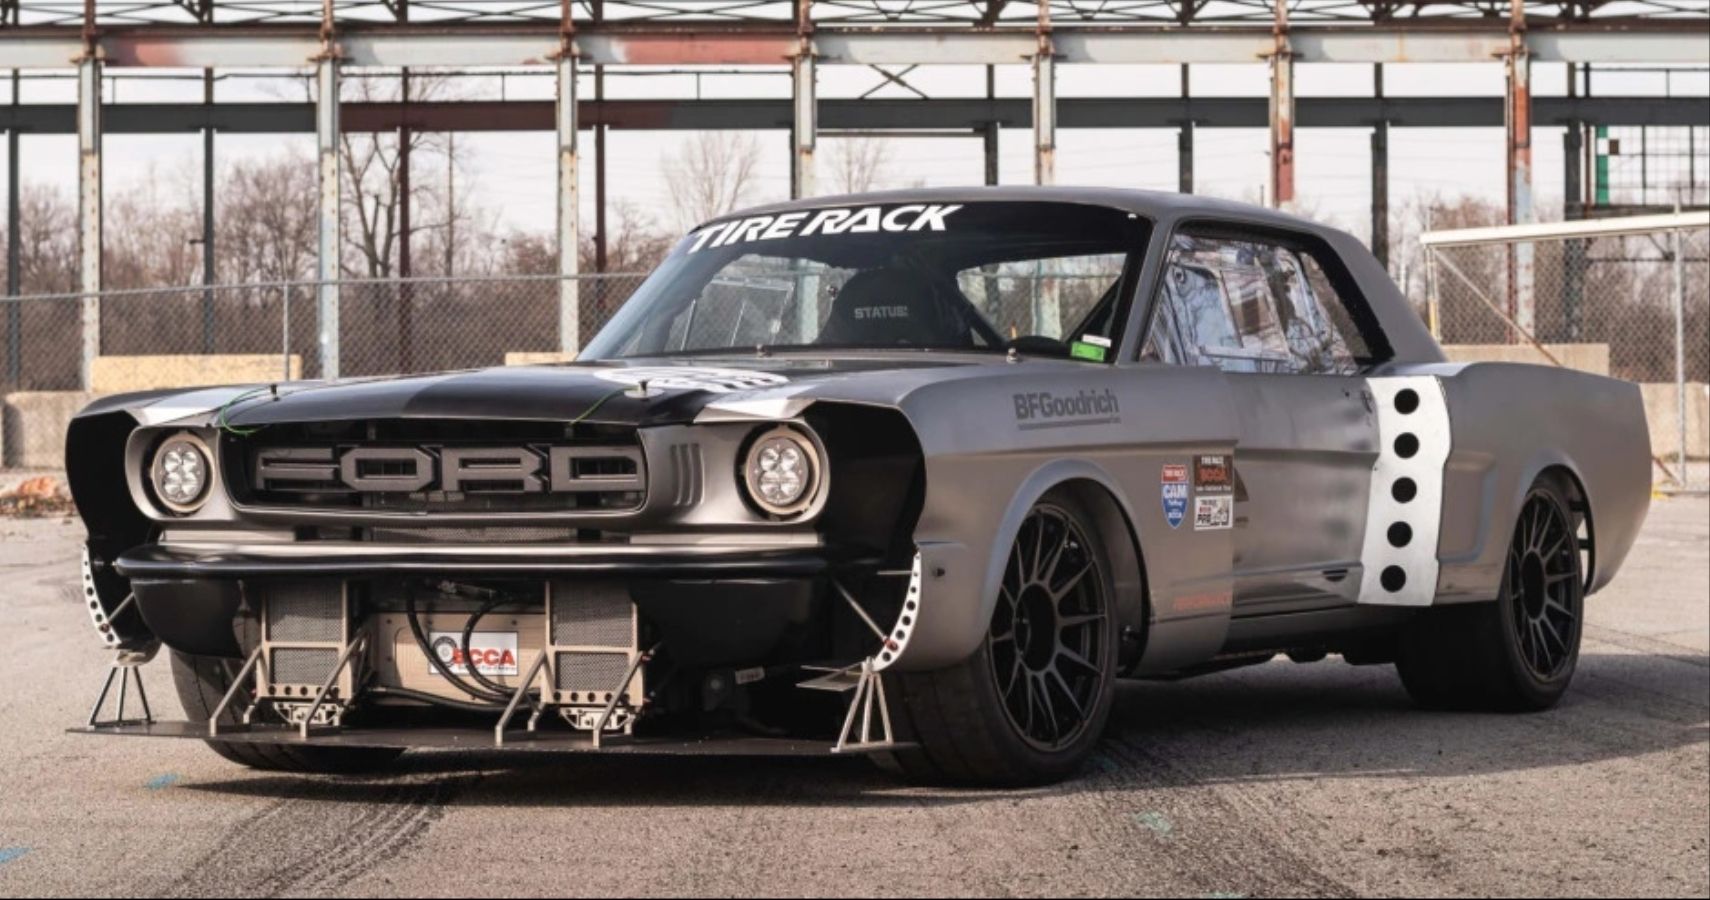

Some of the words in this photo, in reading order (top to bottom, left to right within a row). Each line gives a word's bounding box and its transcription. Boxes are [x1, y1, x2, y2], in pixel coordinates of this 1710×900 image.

[688, 211, 810, 255] TIRE
[799, 204, 963, 236] RACK
[1013, 388, 1120, 420] BFGoodrich
[256, 446, 646, 493] FORD
[1162, 484, 1188, 499] CAM
